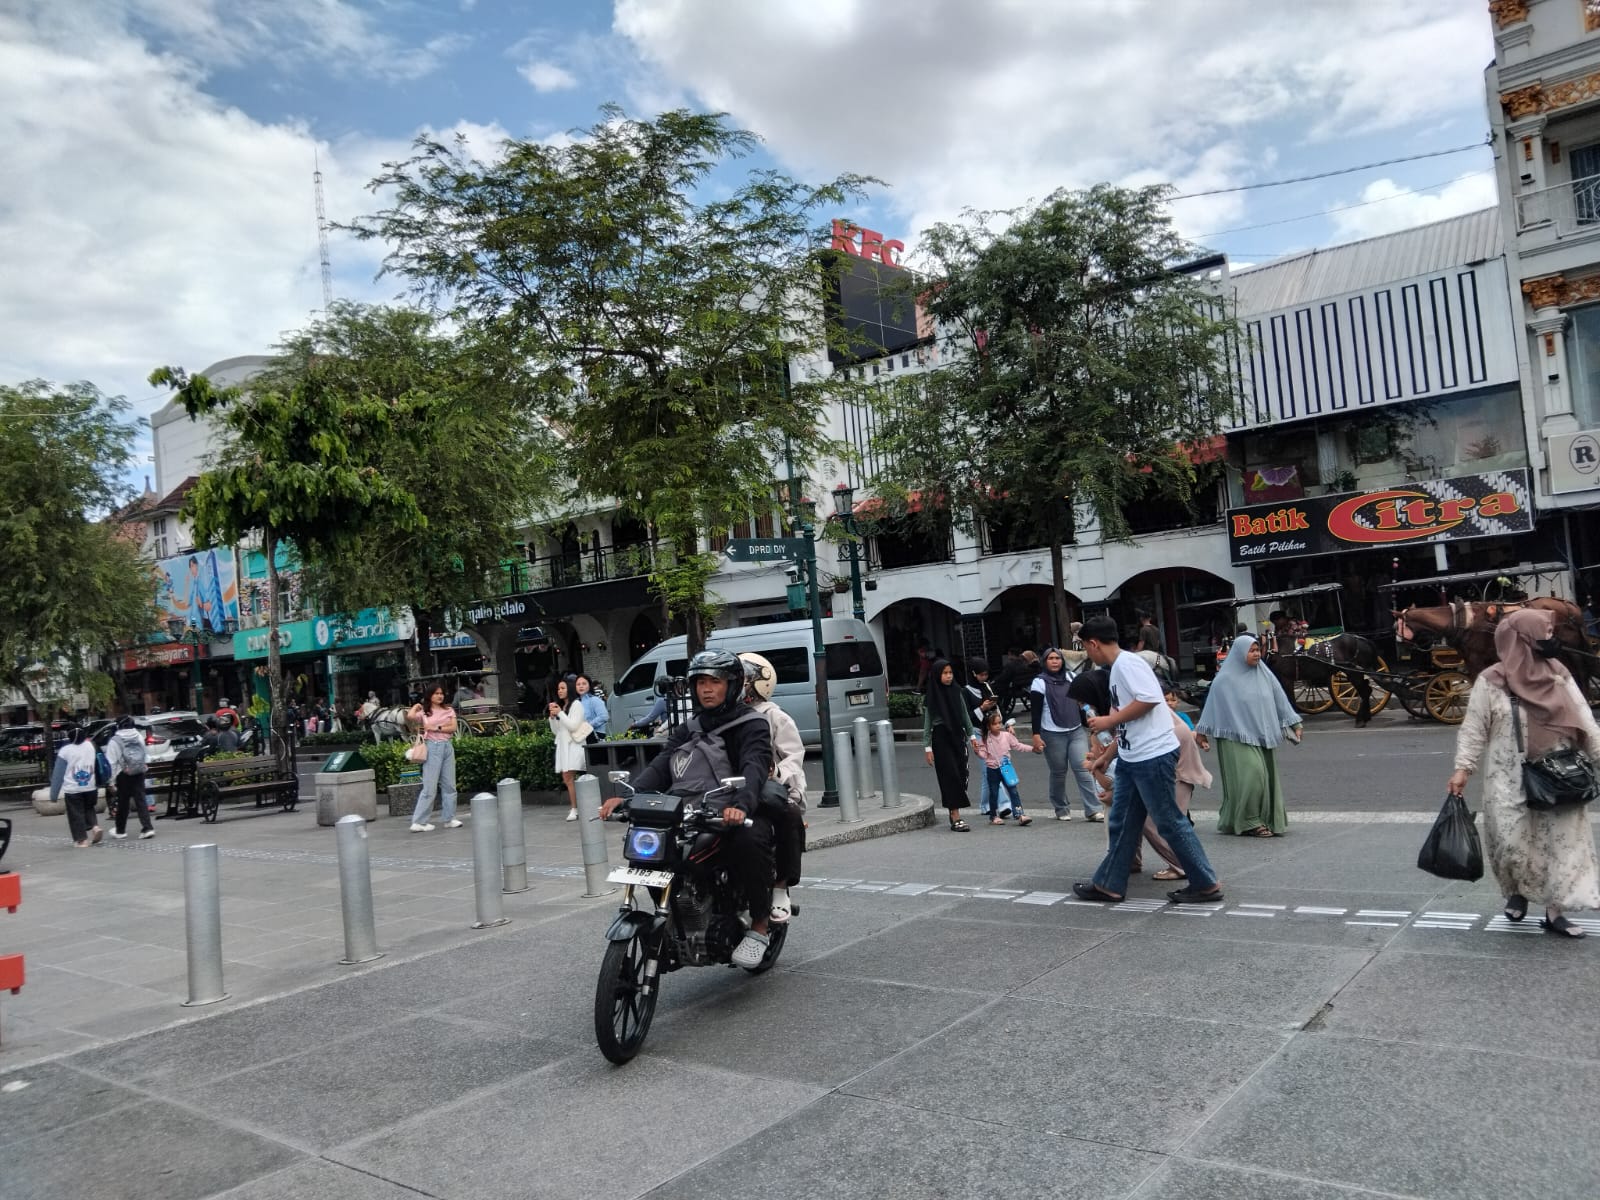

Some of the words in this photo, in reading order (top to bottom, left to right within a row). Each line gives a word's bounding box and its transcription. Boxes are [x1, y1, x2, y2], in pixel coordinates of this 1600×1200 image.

[832, 219, 905, 269] KFC
[1574, 446, 1596, 463] R
[1232, 508, 1310, 537] Batik
[1328, 490, 1520, 543] Citra
[749, 545, 771, 555] DPRD
[773, 544, 786, 554] DIY
[1240, 543, 1267, 556] Batik
[1269, 540, 1307, 553] Pilihan
